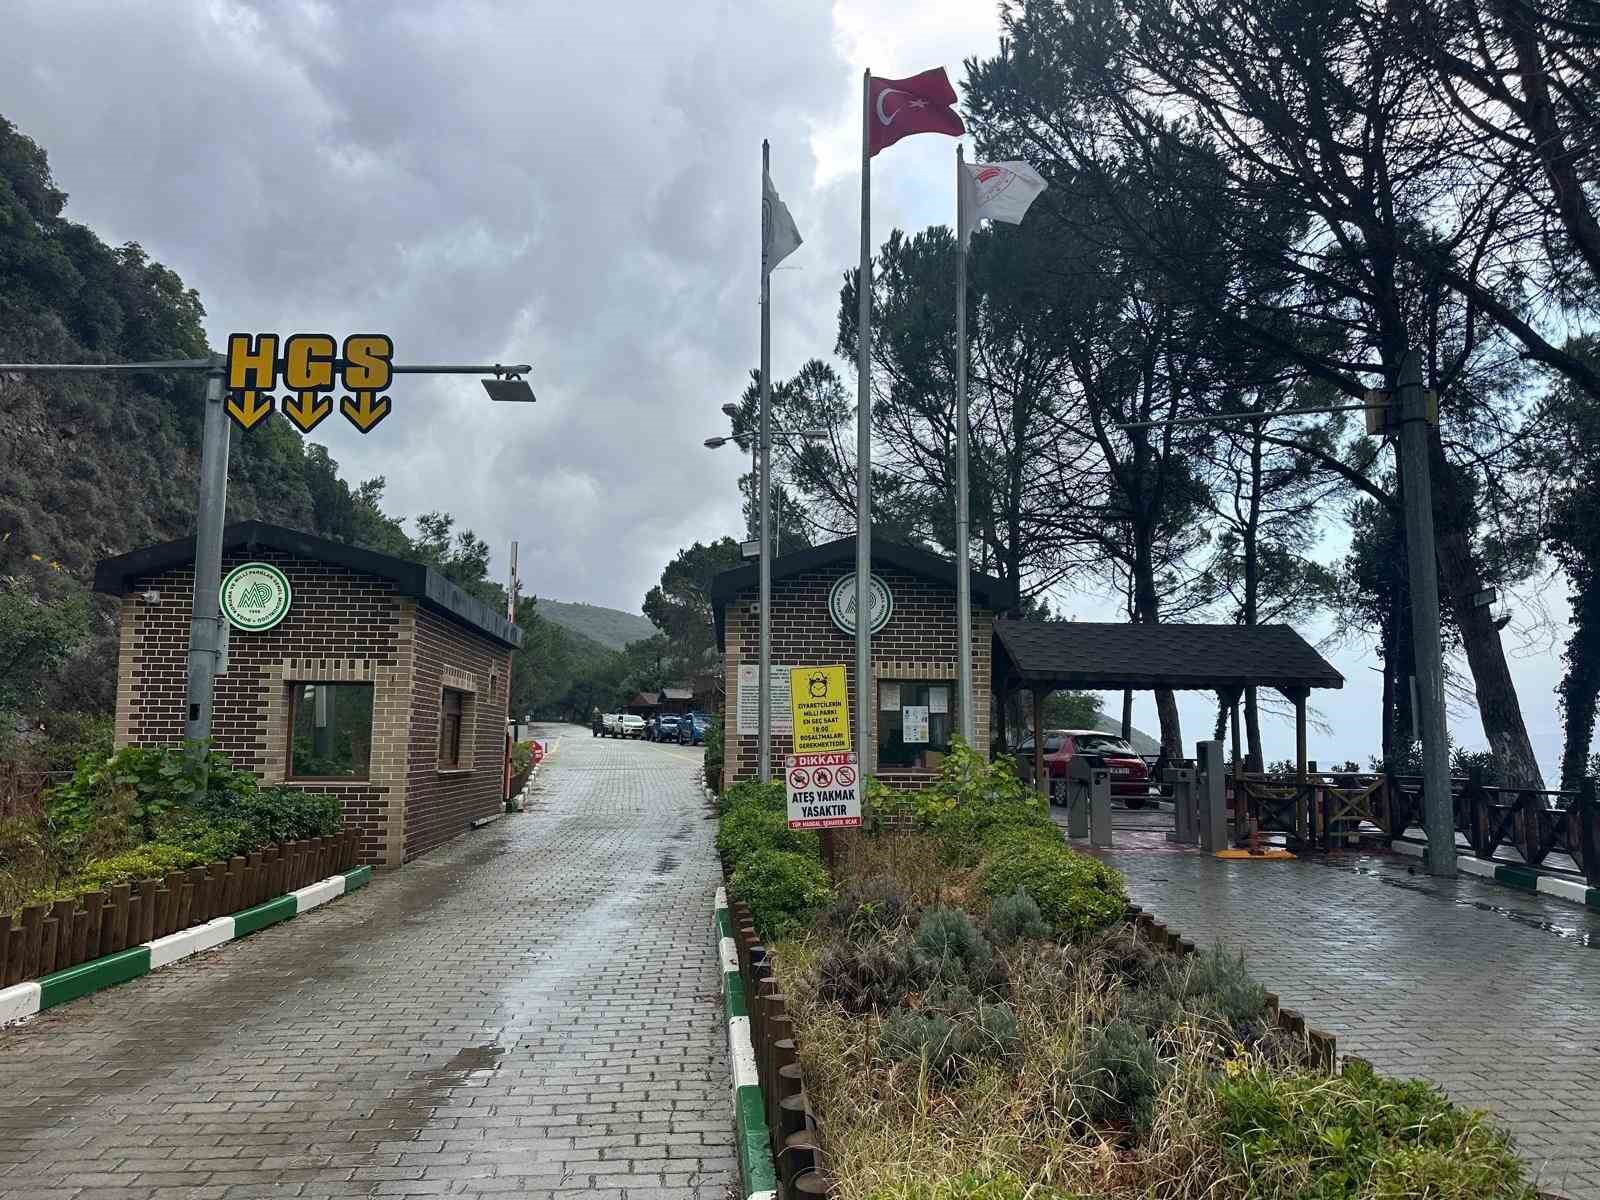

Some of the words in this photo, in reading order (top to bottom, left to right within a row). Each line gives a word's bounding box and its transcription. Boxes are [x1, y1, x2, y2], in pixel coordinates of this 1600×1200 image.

[226, 333, 393, 392] HGS
[792, 792, 814, 805] ATEŞ
[816, 790, 854, 802] YAKMAK
[802, 804, 846, 817] YASAKTIR
